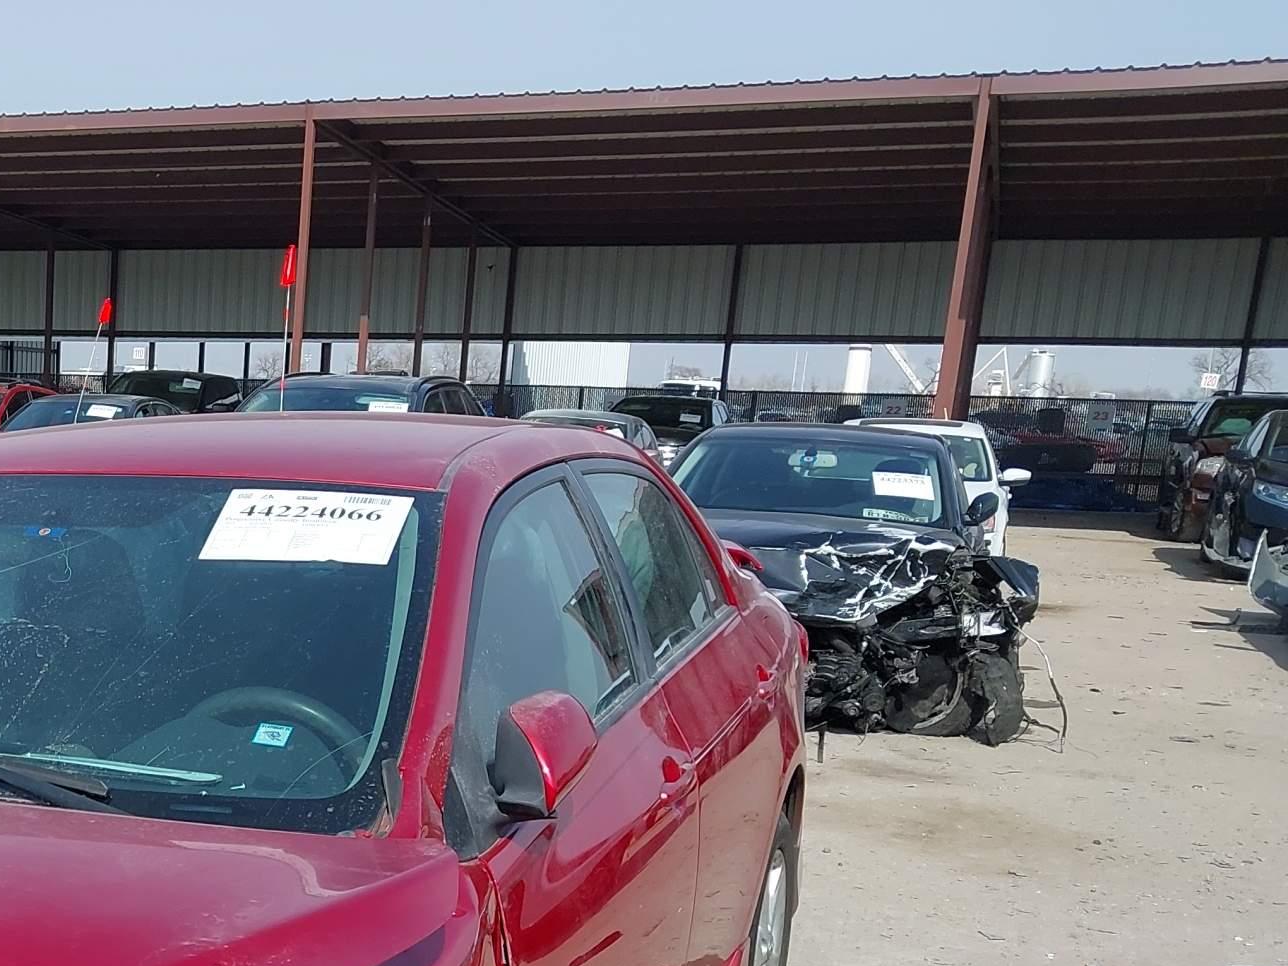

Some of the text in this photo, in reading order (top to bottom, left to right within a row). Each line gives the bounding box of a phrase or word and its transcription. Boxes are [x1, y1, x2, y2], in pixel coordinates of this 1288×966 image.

[886, 406, 902, 415] 22
[1092, 411, 1110, 421] 23
[239, 503, 385, 522] 44224066
